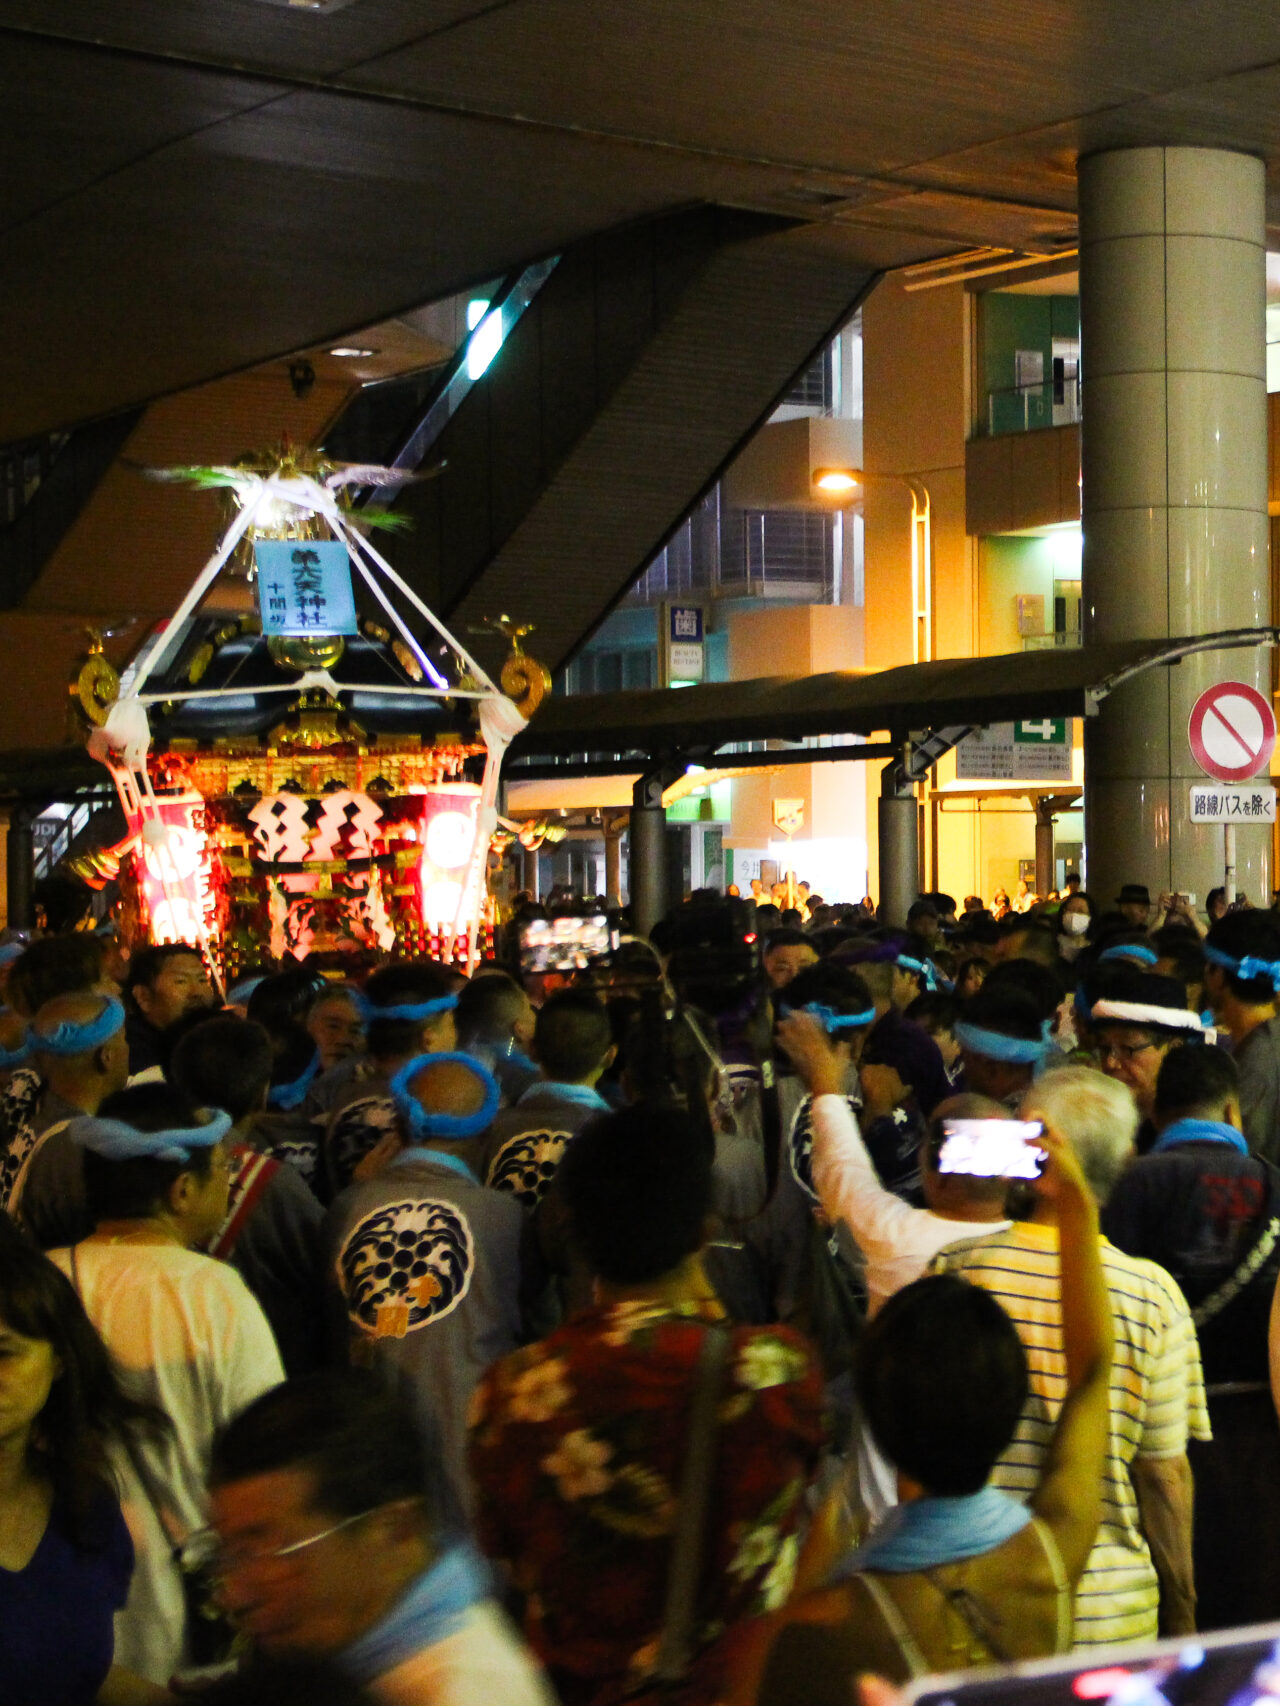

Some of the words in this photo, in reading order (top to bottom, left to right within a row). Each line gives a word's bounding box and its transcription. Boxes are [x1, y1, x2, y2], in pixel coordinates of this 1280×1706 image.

[1021, 719, 1056, 740] 4
[1194, 794, 1271, 816] 路線バスを除く
